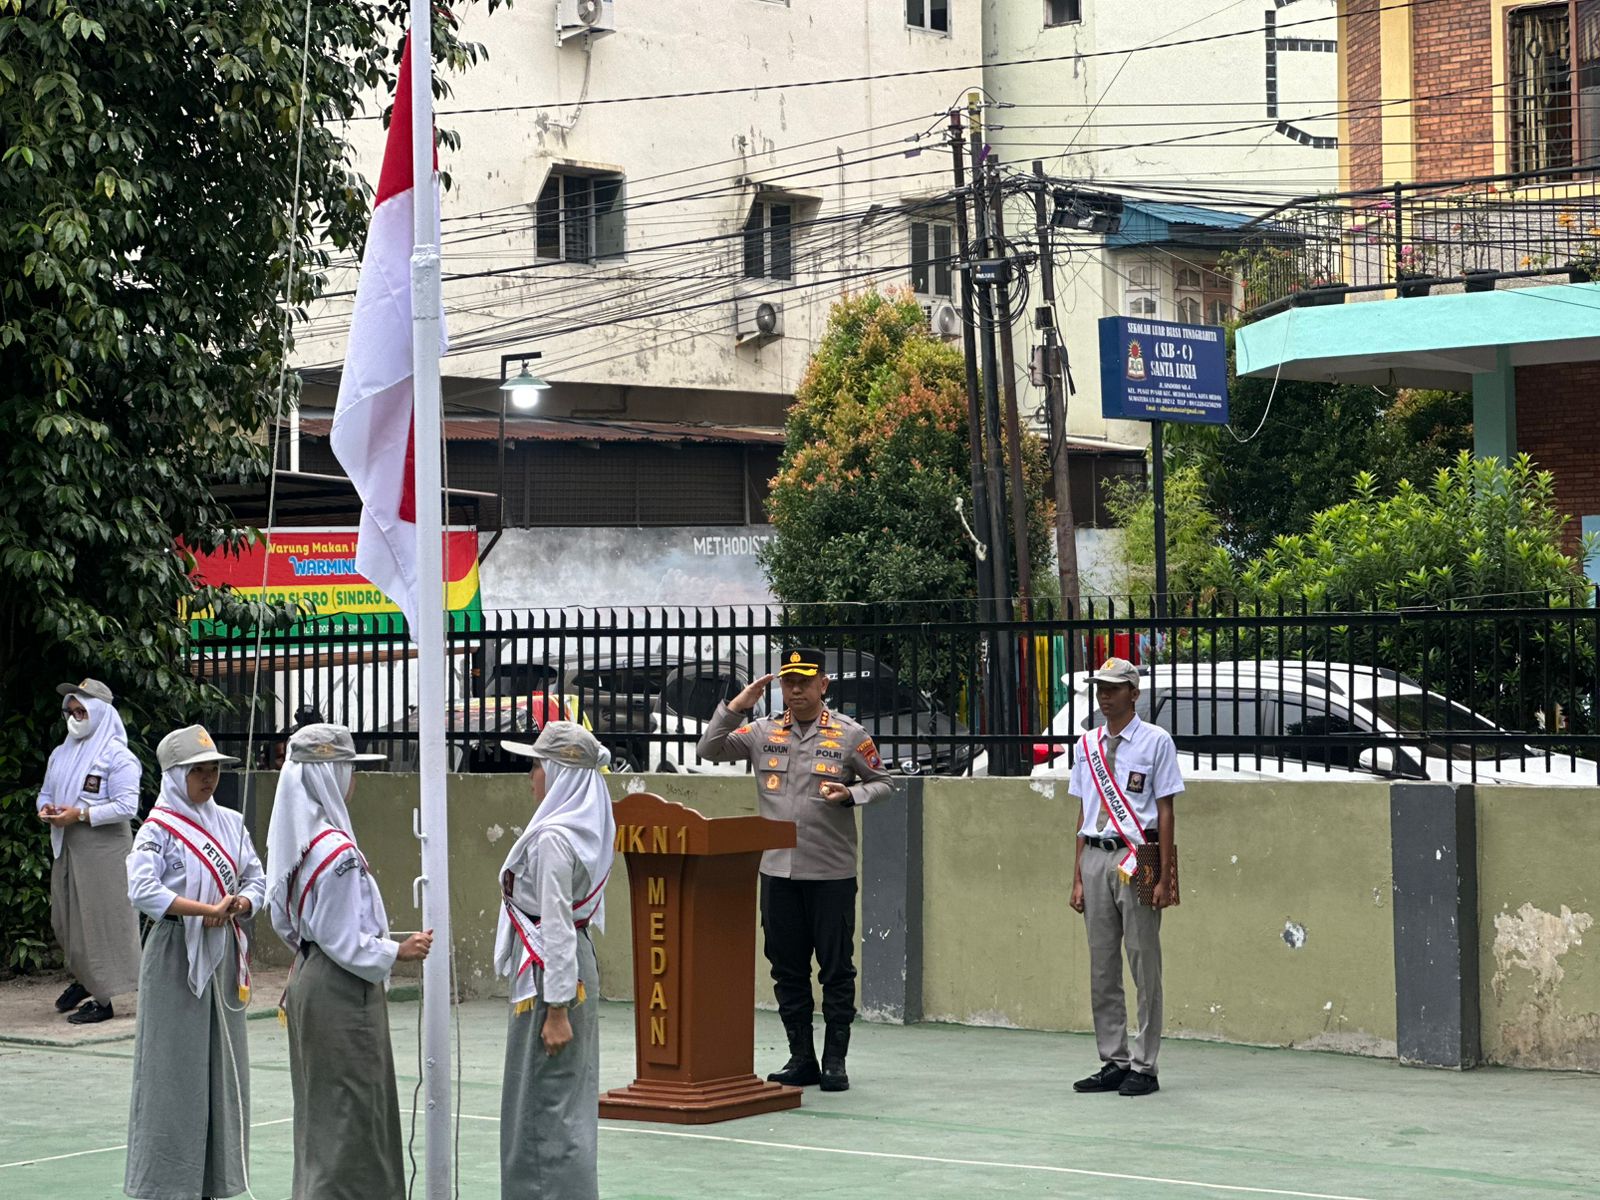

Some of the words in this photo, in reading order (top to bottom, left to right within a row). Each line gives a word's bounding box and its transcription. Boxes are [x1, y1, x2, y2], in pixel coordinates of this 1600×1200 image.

[1150, 360, 1175, 378] SANTA
[1175, 362, 1198, 380] LUSIA
[267, 542, 309, 556] Warung
[312, 541, 349, 553] Makan
[693, 535, 769, 556] METHODIST
[815, 749, 842, 760] POLRI
[1091, 750, 1110, 787] PETUGAS
[1104, 784, 1128, 823] UPACARA
[676, 825, 688, 854] 1
[202, 842, 234, 886] PETUGAS
[648, 876, 668, 1047] MEDAN
